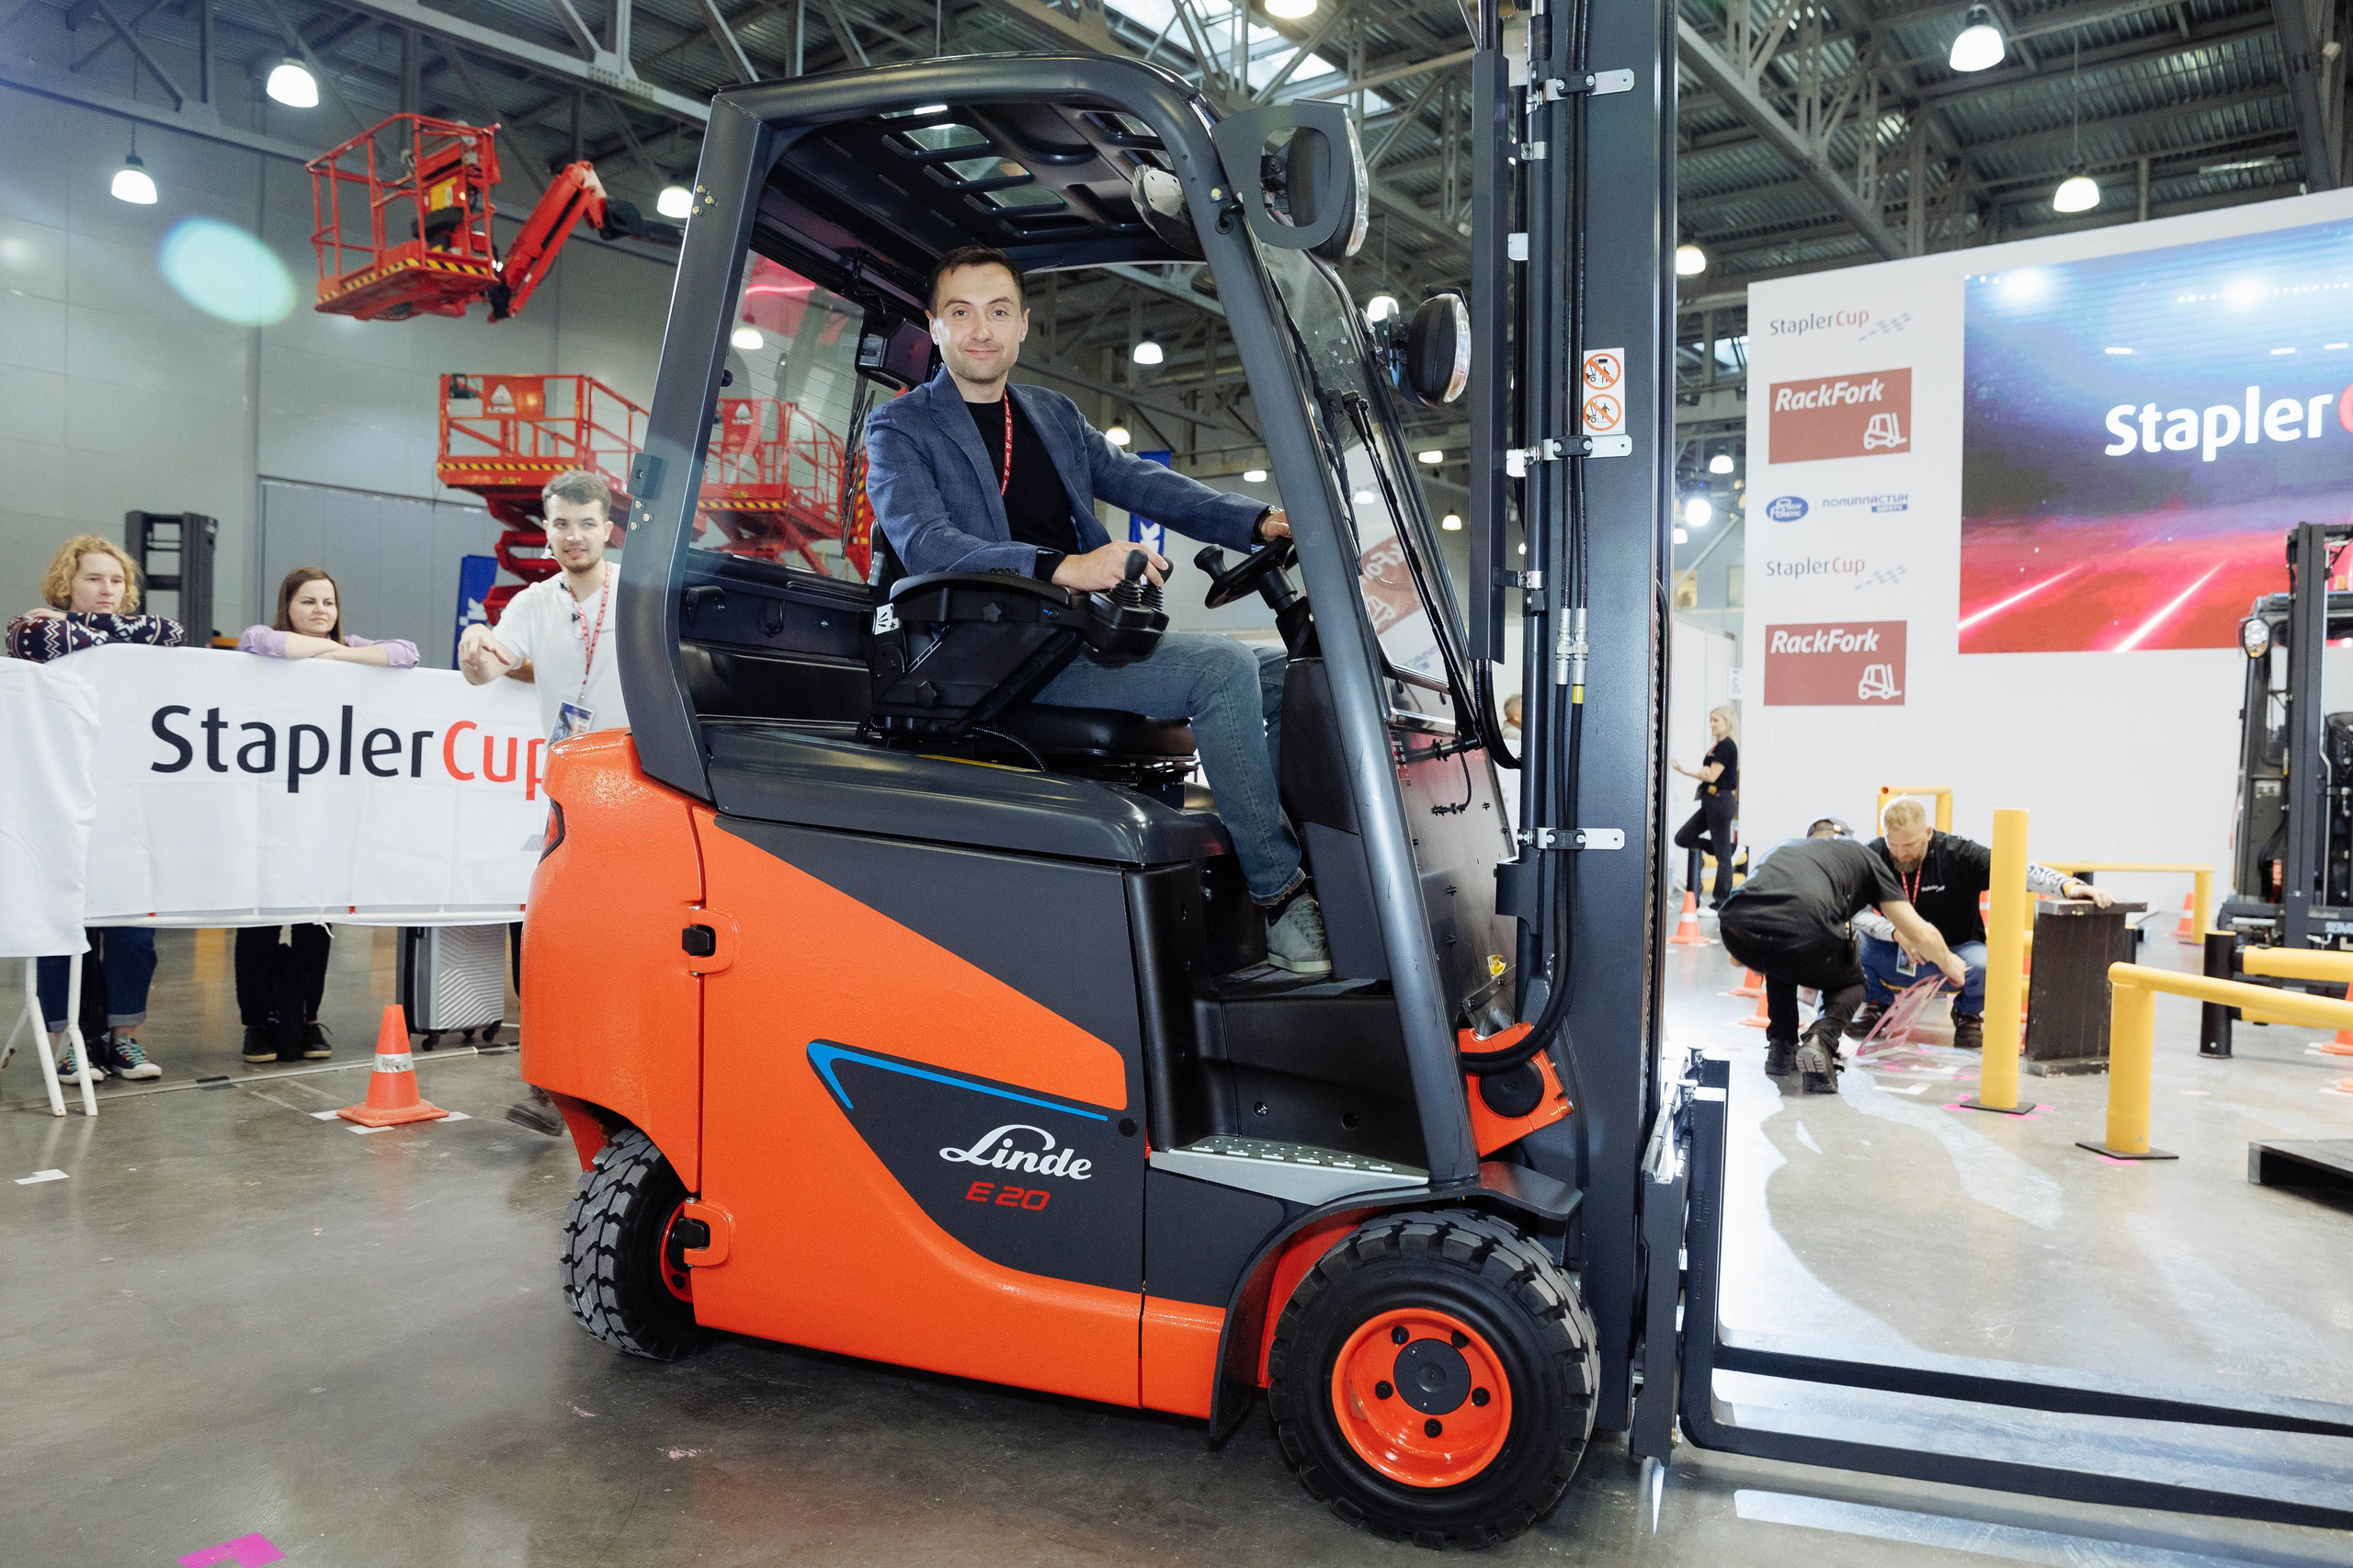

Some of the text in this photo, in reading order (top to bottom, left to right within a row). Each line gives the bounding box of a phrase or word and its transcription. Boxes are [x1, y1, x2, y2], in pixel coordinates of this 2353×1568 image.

[1769, 310, 1870, 336] StaplerCup
[1775, 378, 1884, 412] RackFork
[1766, 557, 1866, 579] StaplerCup
[1769, 628, 1881, 654] RackFork
[938, 1124, 1092, 1180] Linde
[965, 1180, 1051, 1210] E 20
